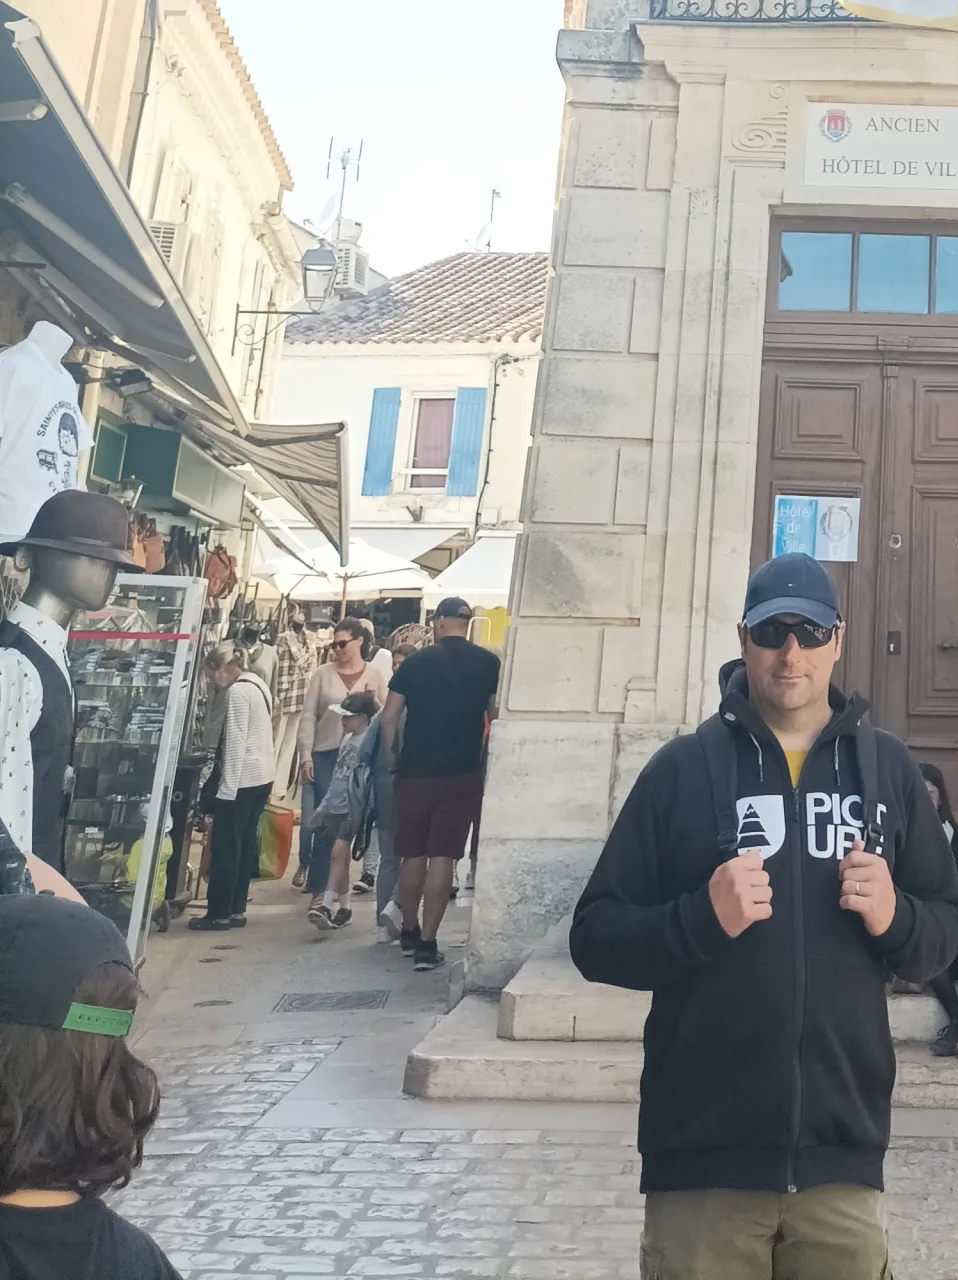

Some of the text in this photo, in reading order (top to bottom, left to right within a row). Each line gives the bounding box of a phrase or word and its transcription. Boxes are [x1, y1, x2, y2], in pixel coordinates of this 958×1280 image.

[865, 116, 940, 133] ANCIEN
[822, 155, 887, 175] HÔTEL
[893, 161, 918, 176] DE
[780, 503, 811, 517] Hôtel
[787, 521, 801, 533] de
[781, 539, 805, 554] Ville
